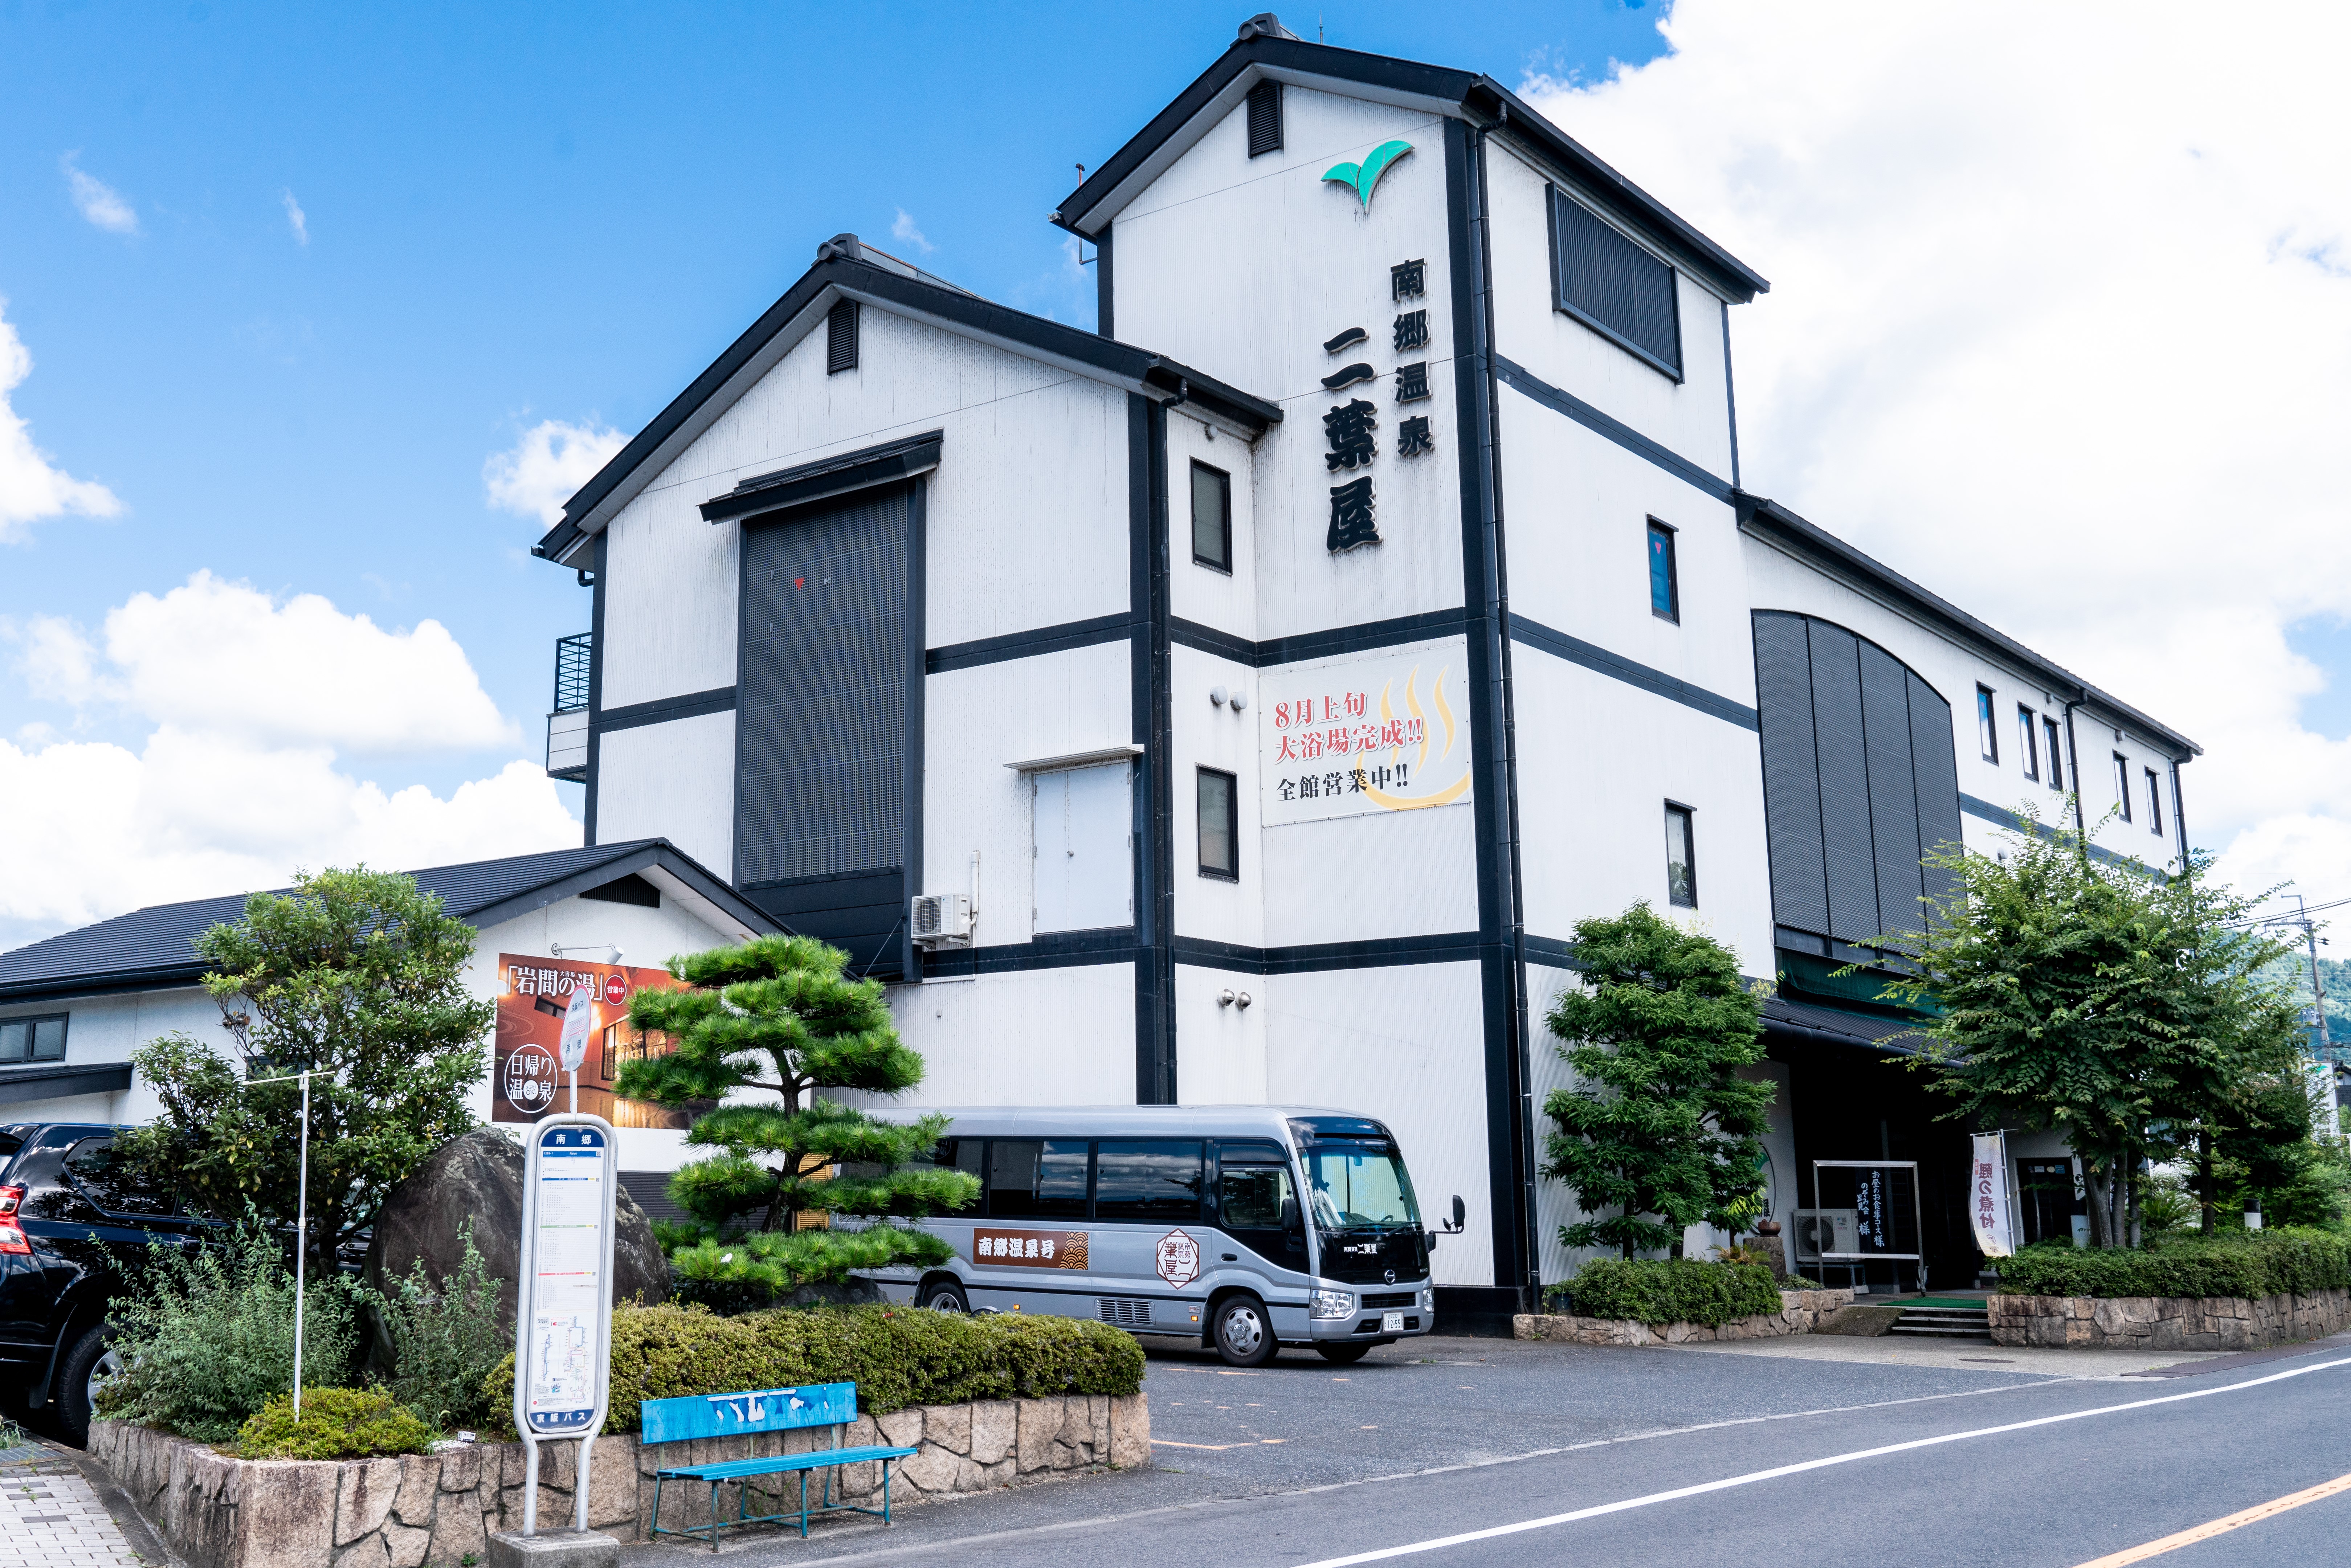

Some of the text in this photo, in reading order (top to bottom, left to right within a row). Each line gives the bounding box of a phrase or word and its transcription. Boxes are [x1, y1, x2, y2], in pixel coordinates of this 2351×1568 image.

[1391, 258, 1434, 456] 南郷温泉
[1321, 327, 1382, 552] 二葉屋
[1275, 691, 1367, 729] 8月上旬
[1274, 718, 1424, 764] 大浴場完成!!
[1277, 763, 1408, 801] 全館営業中!!
[607, 985, 624, 995] 営業中
[571, 1000, 584, 1012] 京阪バス
[511, 1054, 552, 1076] 日帰り
[556, 1134, 591, 1145] 南郷
[979, 1237, 1055, 1259] 南郷温泉号
[1388, 1319, 1400, 1328] 12-55
[536, 1412, 585, 1423] 京阪バス
